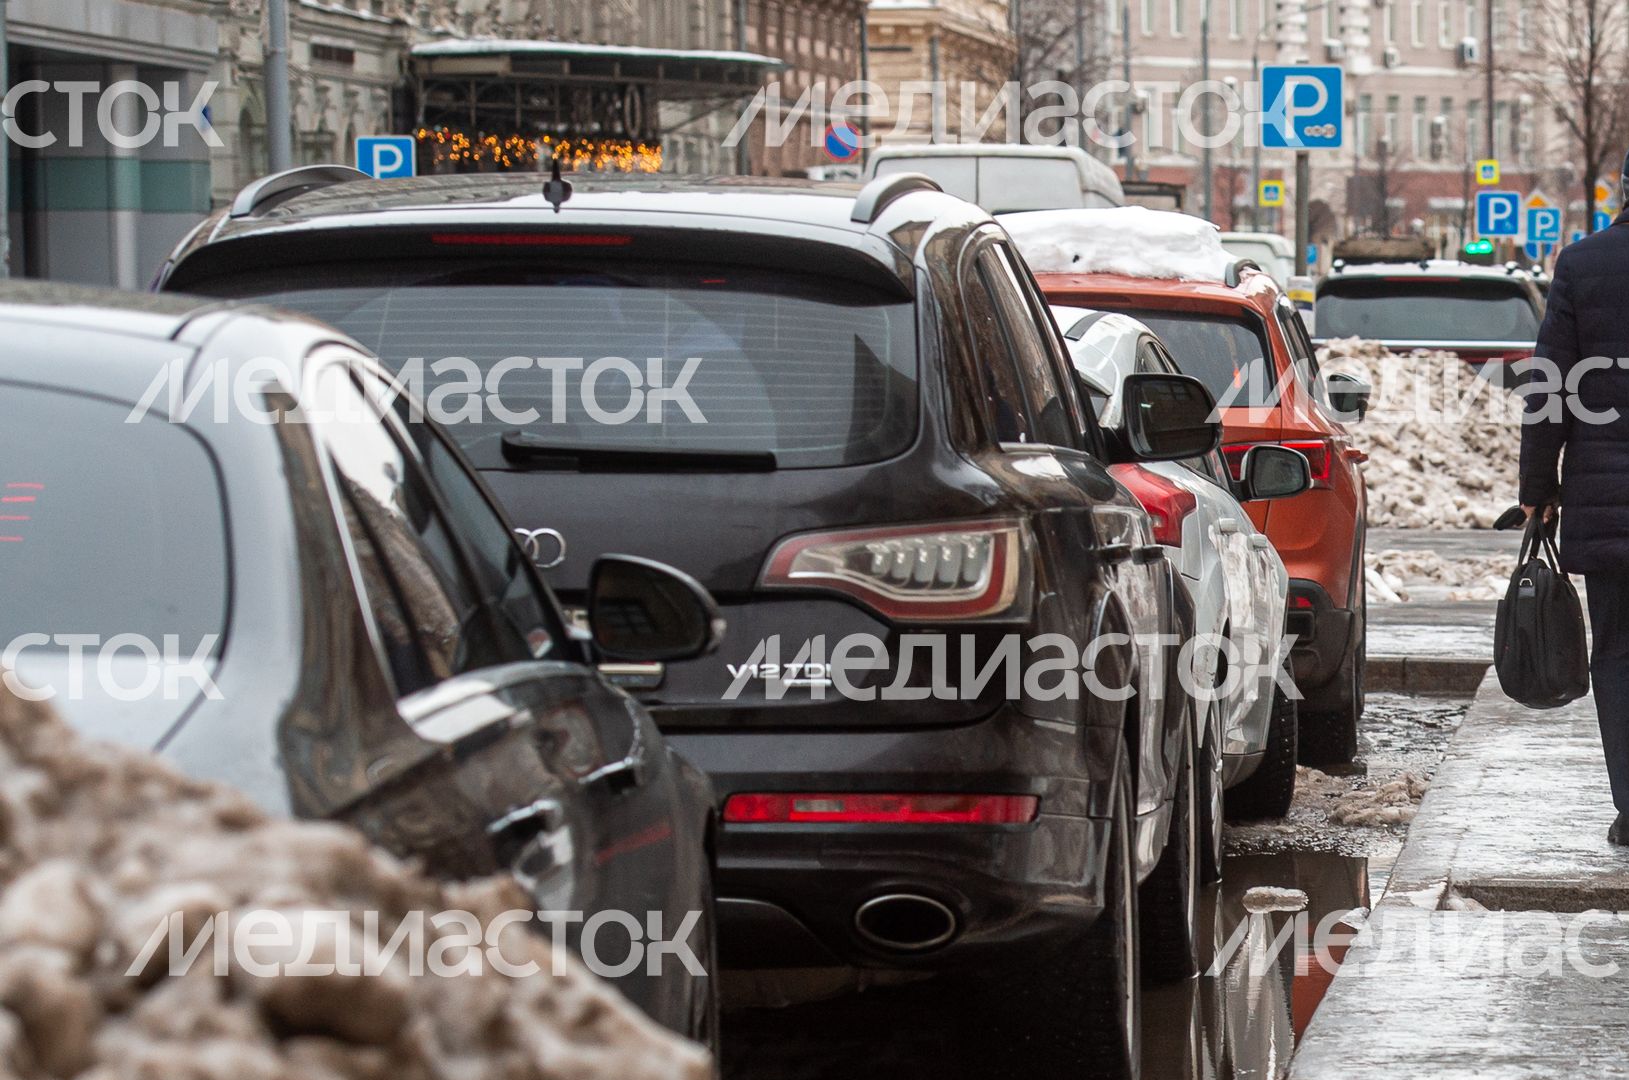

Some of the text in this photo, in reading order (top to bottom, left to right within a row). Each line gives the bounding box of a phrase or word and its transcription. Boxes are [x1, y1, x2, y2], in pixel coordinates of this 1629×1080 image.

[1285, 75, 1329, 139] P
[373, 144, 403, 180] P
[1488, 197, 1513, 231] P
[1535, 211, 1554, 238] P
